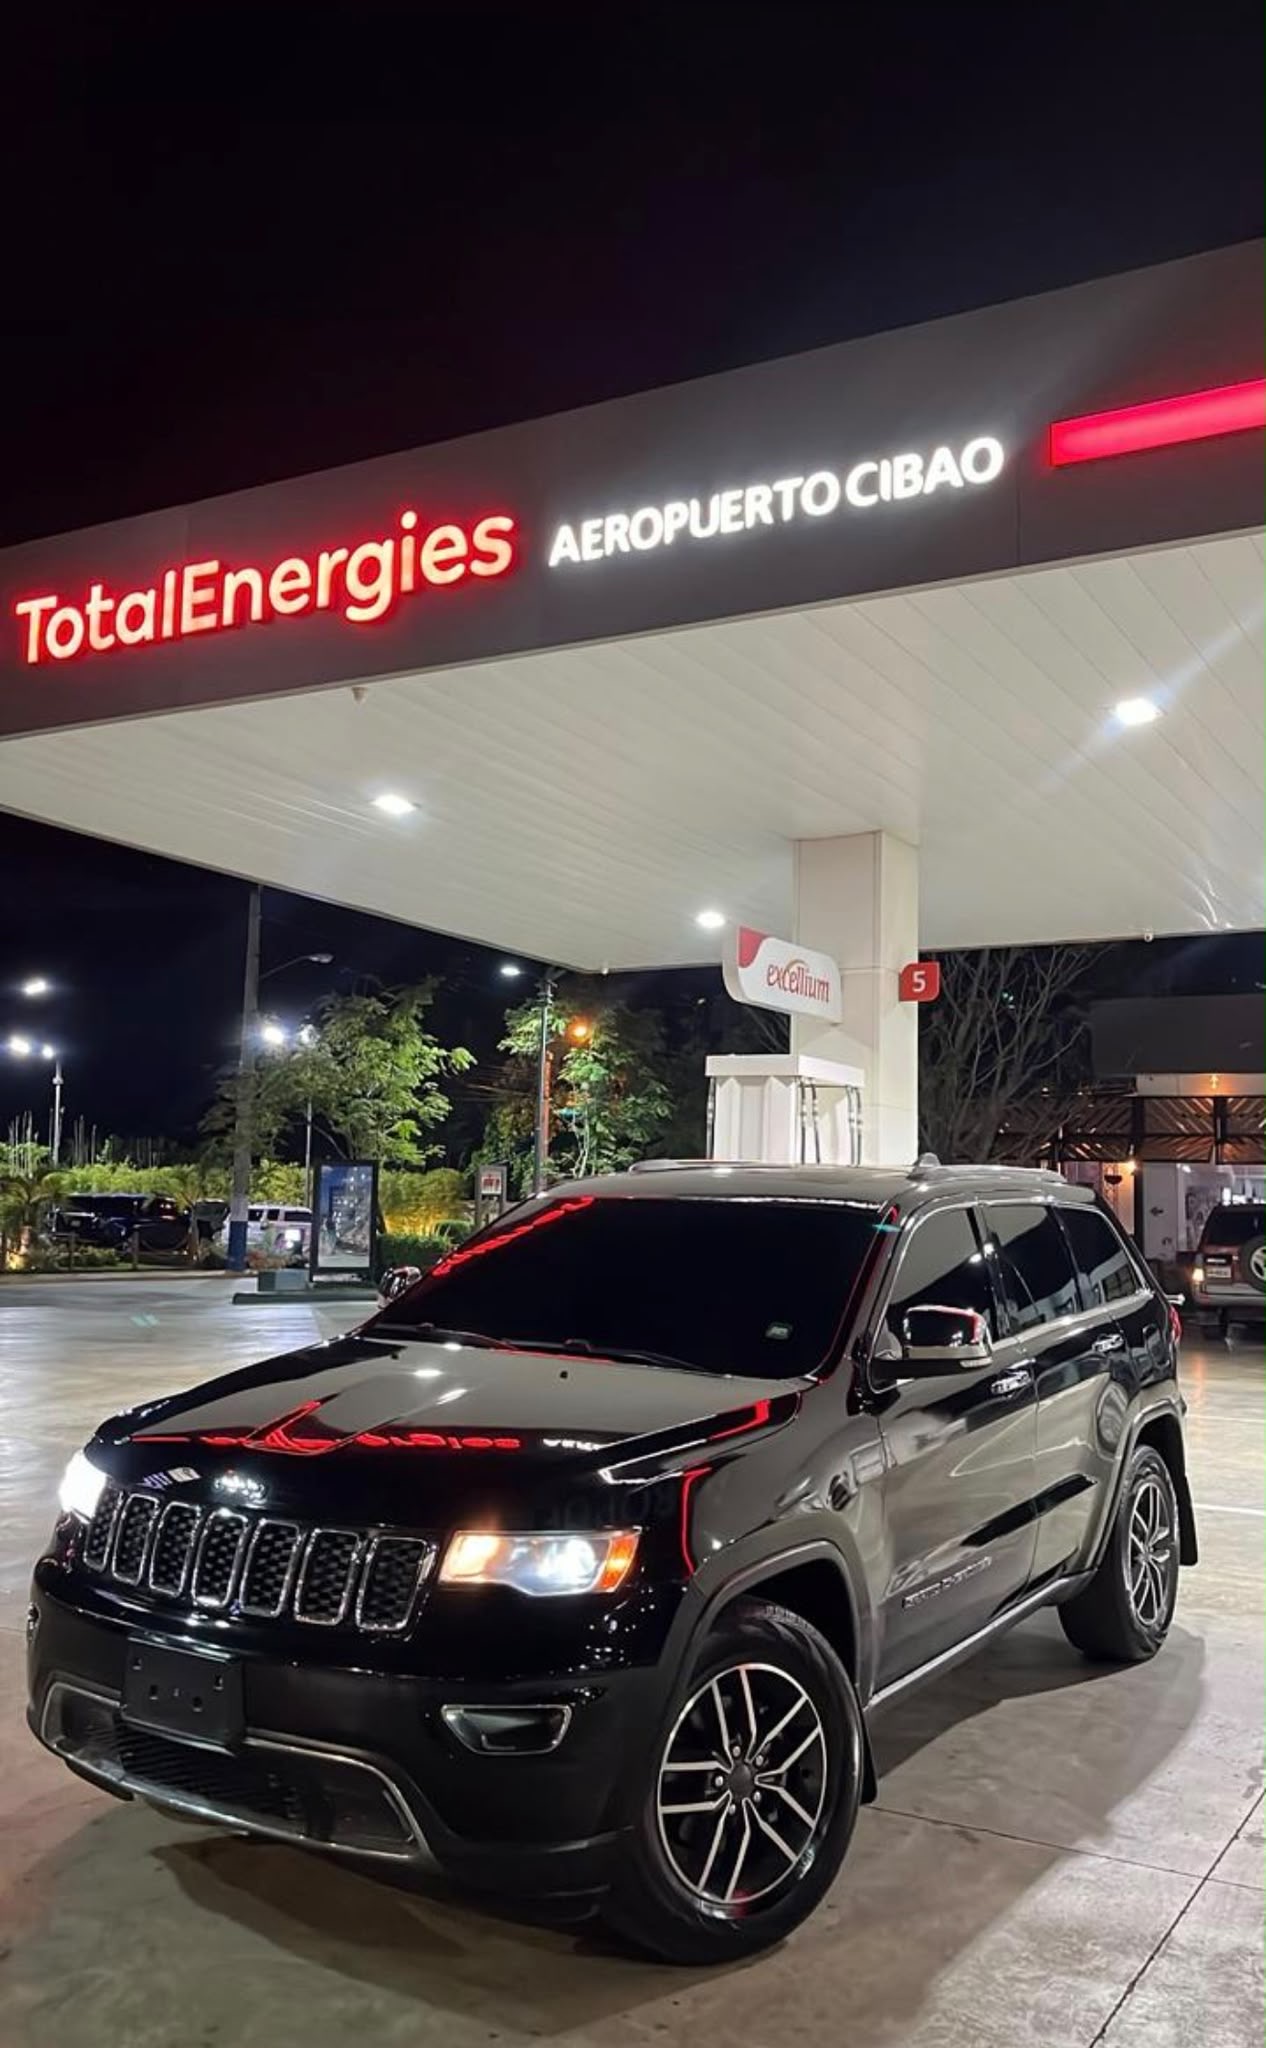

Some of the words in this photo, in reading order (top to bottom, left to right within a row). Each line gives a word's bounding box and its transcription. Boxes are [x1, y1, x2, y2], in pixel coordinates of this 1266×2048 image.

[548, 469, 841, 568] AEROPUERTO
[843, 436, 1006, 508] CIBAO
[14, 510, 516, 664] TotalEnergies
[766, 963, 830, 1003] excellium
[912, 970, 926, 993] 5
